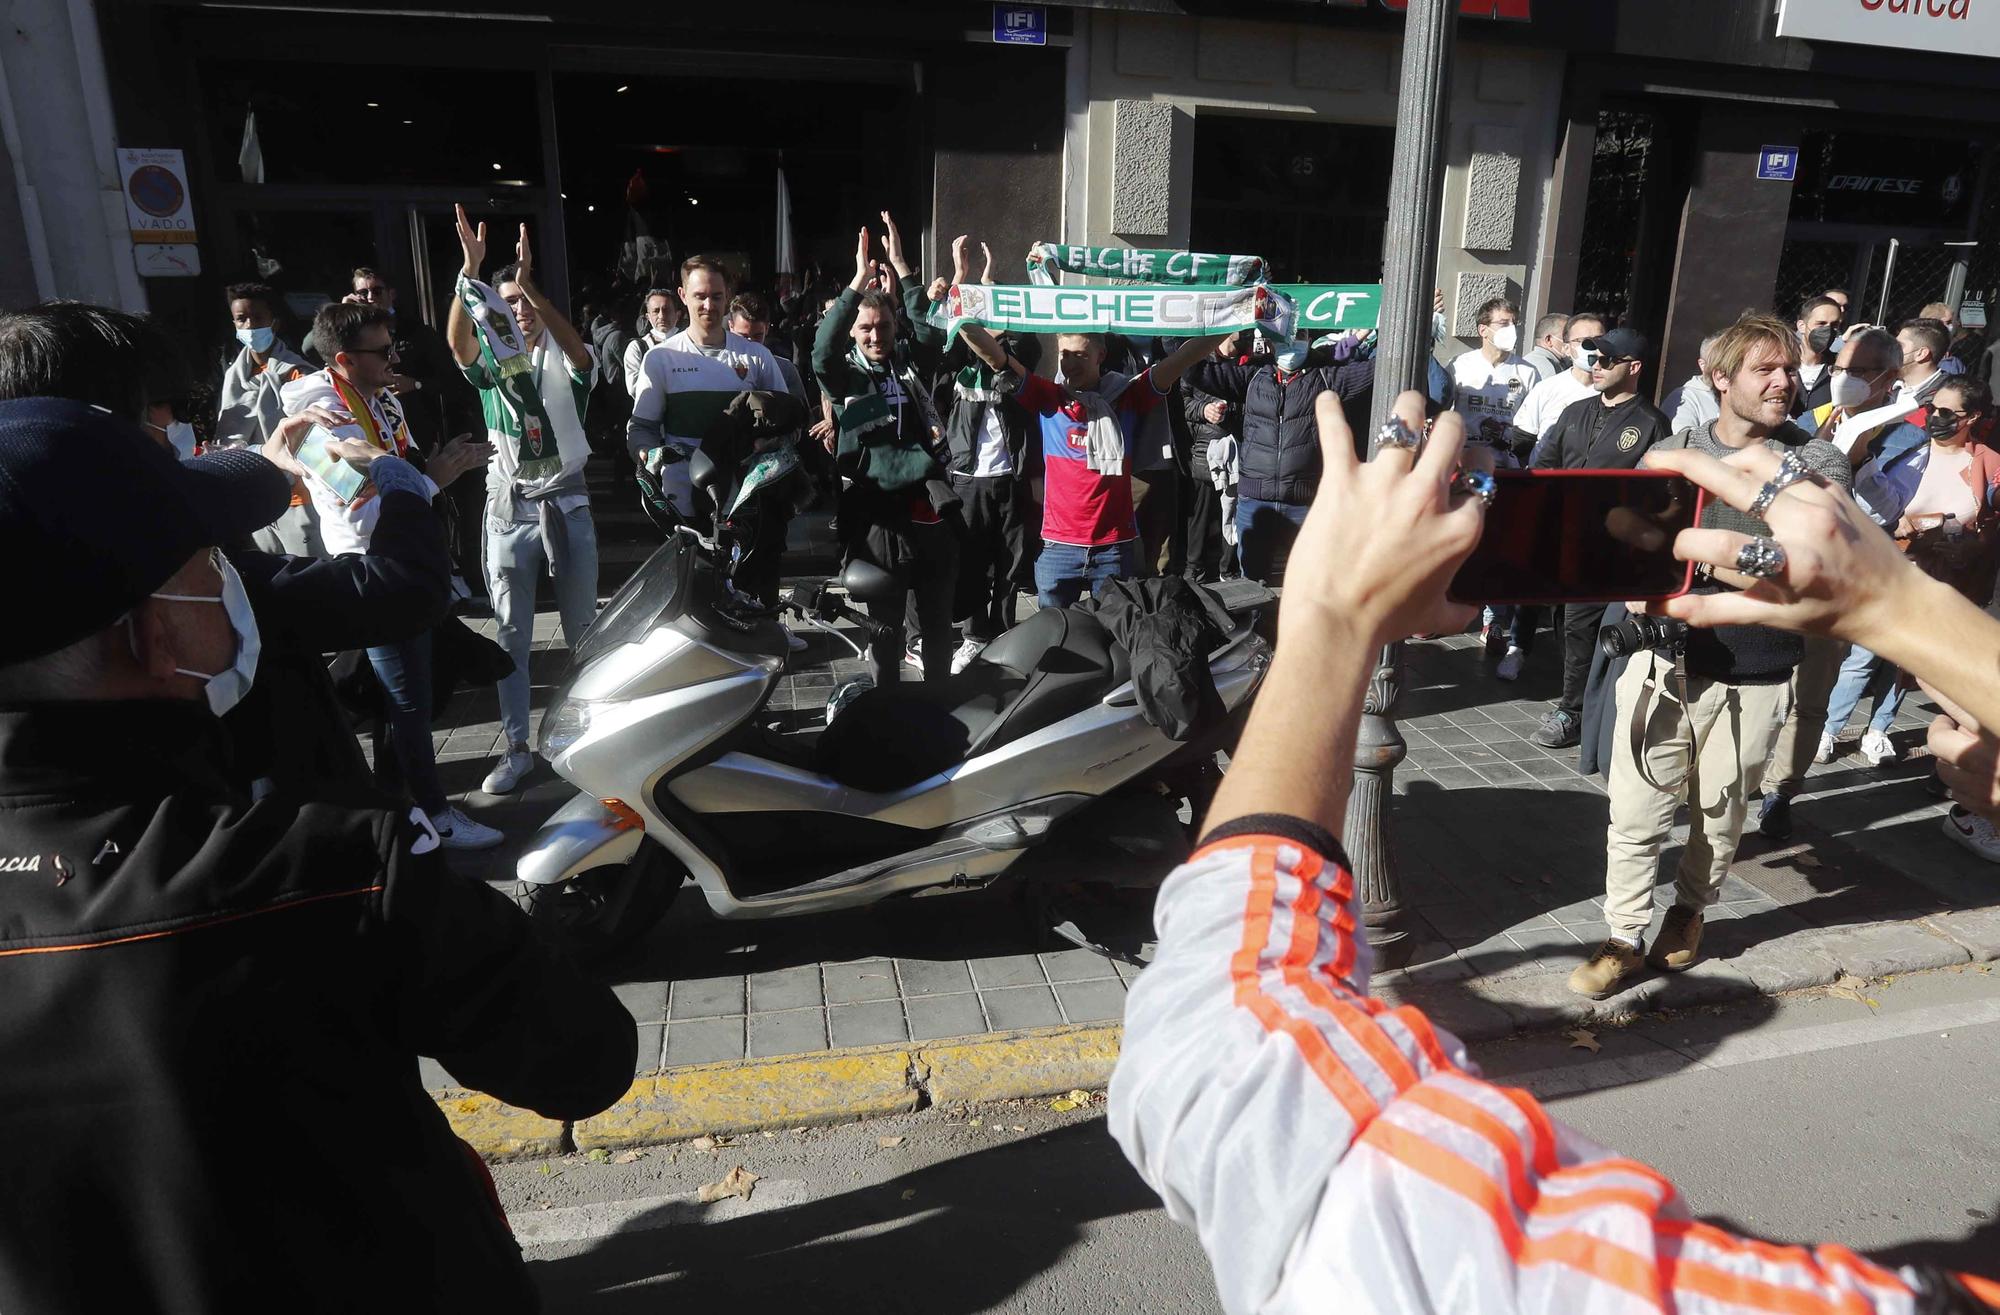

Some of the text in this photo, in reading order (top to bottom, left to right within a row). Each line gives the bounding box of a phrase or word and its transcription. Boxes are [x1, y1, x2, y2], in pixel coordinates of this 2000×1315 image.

[1007, 12, 1033, 28] IFI
[1768, 153, 1789, 168] IFI
[1827, 175, 1924, 194] DAINESE
[138, 219, 187, 230] VADO
[1068, 246, 1220, 277] ELCHE CF
[1305, 291, 1371, 326] CF
